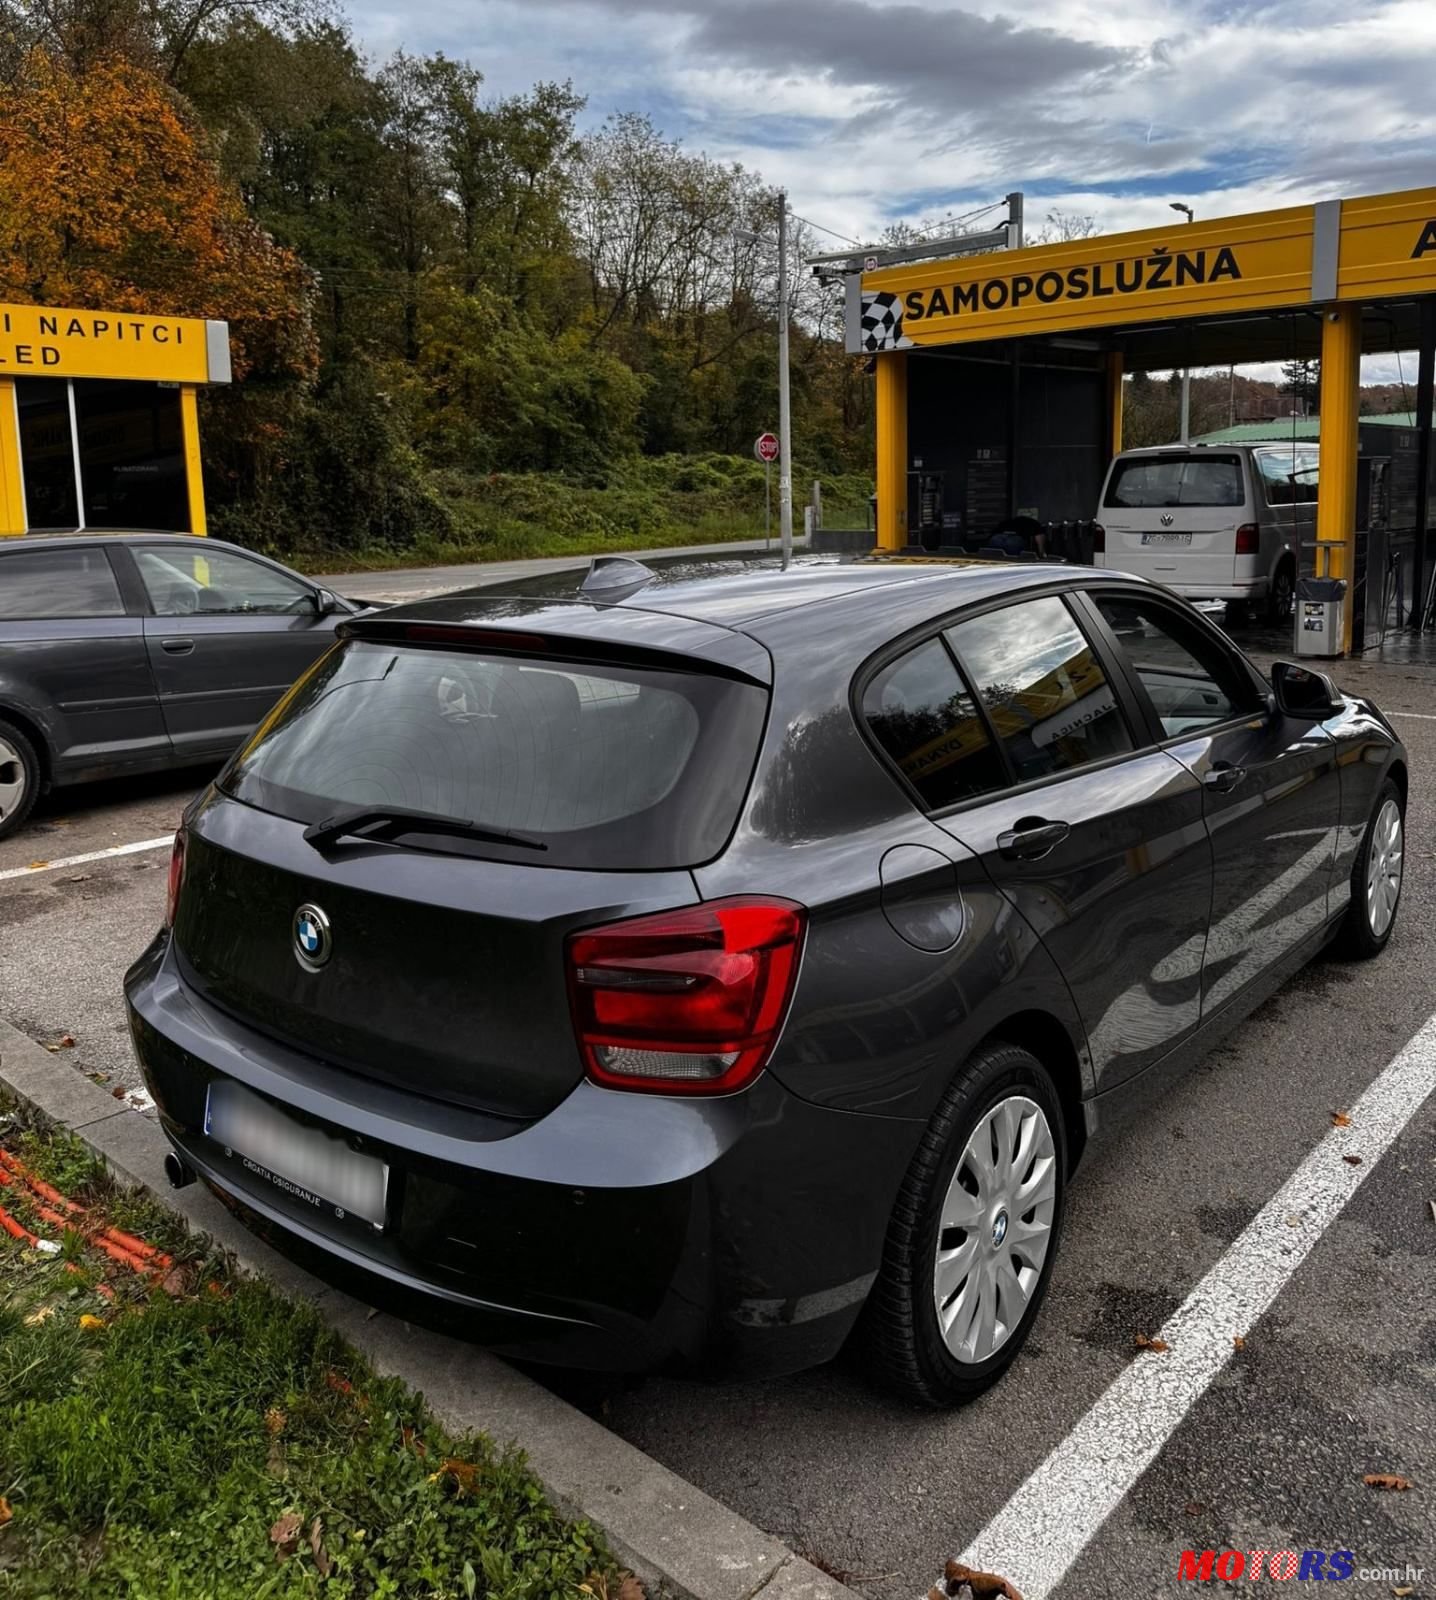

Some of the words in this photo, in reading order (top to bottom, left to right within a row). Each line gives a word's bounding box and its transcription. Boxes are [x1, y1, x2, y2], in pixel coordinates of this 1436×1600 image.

[905, 247, 1242, 321] SAMOPOSLUŽNA
[39, 315, 182, 344] NAPITCI
[243, 1158, 271, 1181] CROATIA
[272, 1175, 321, 1207] OSIGURANJE
